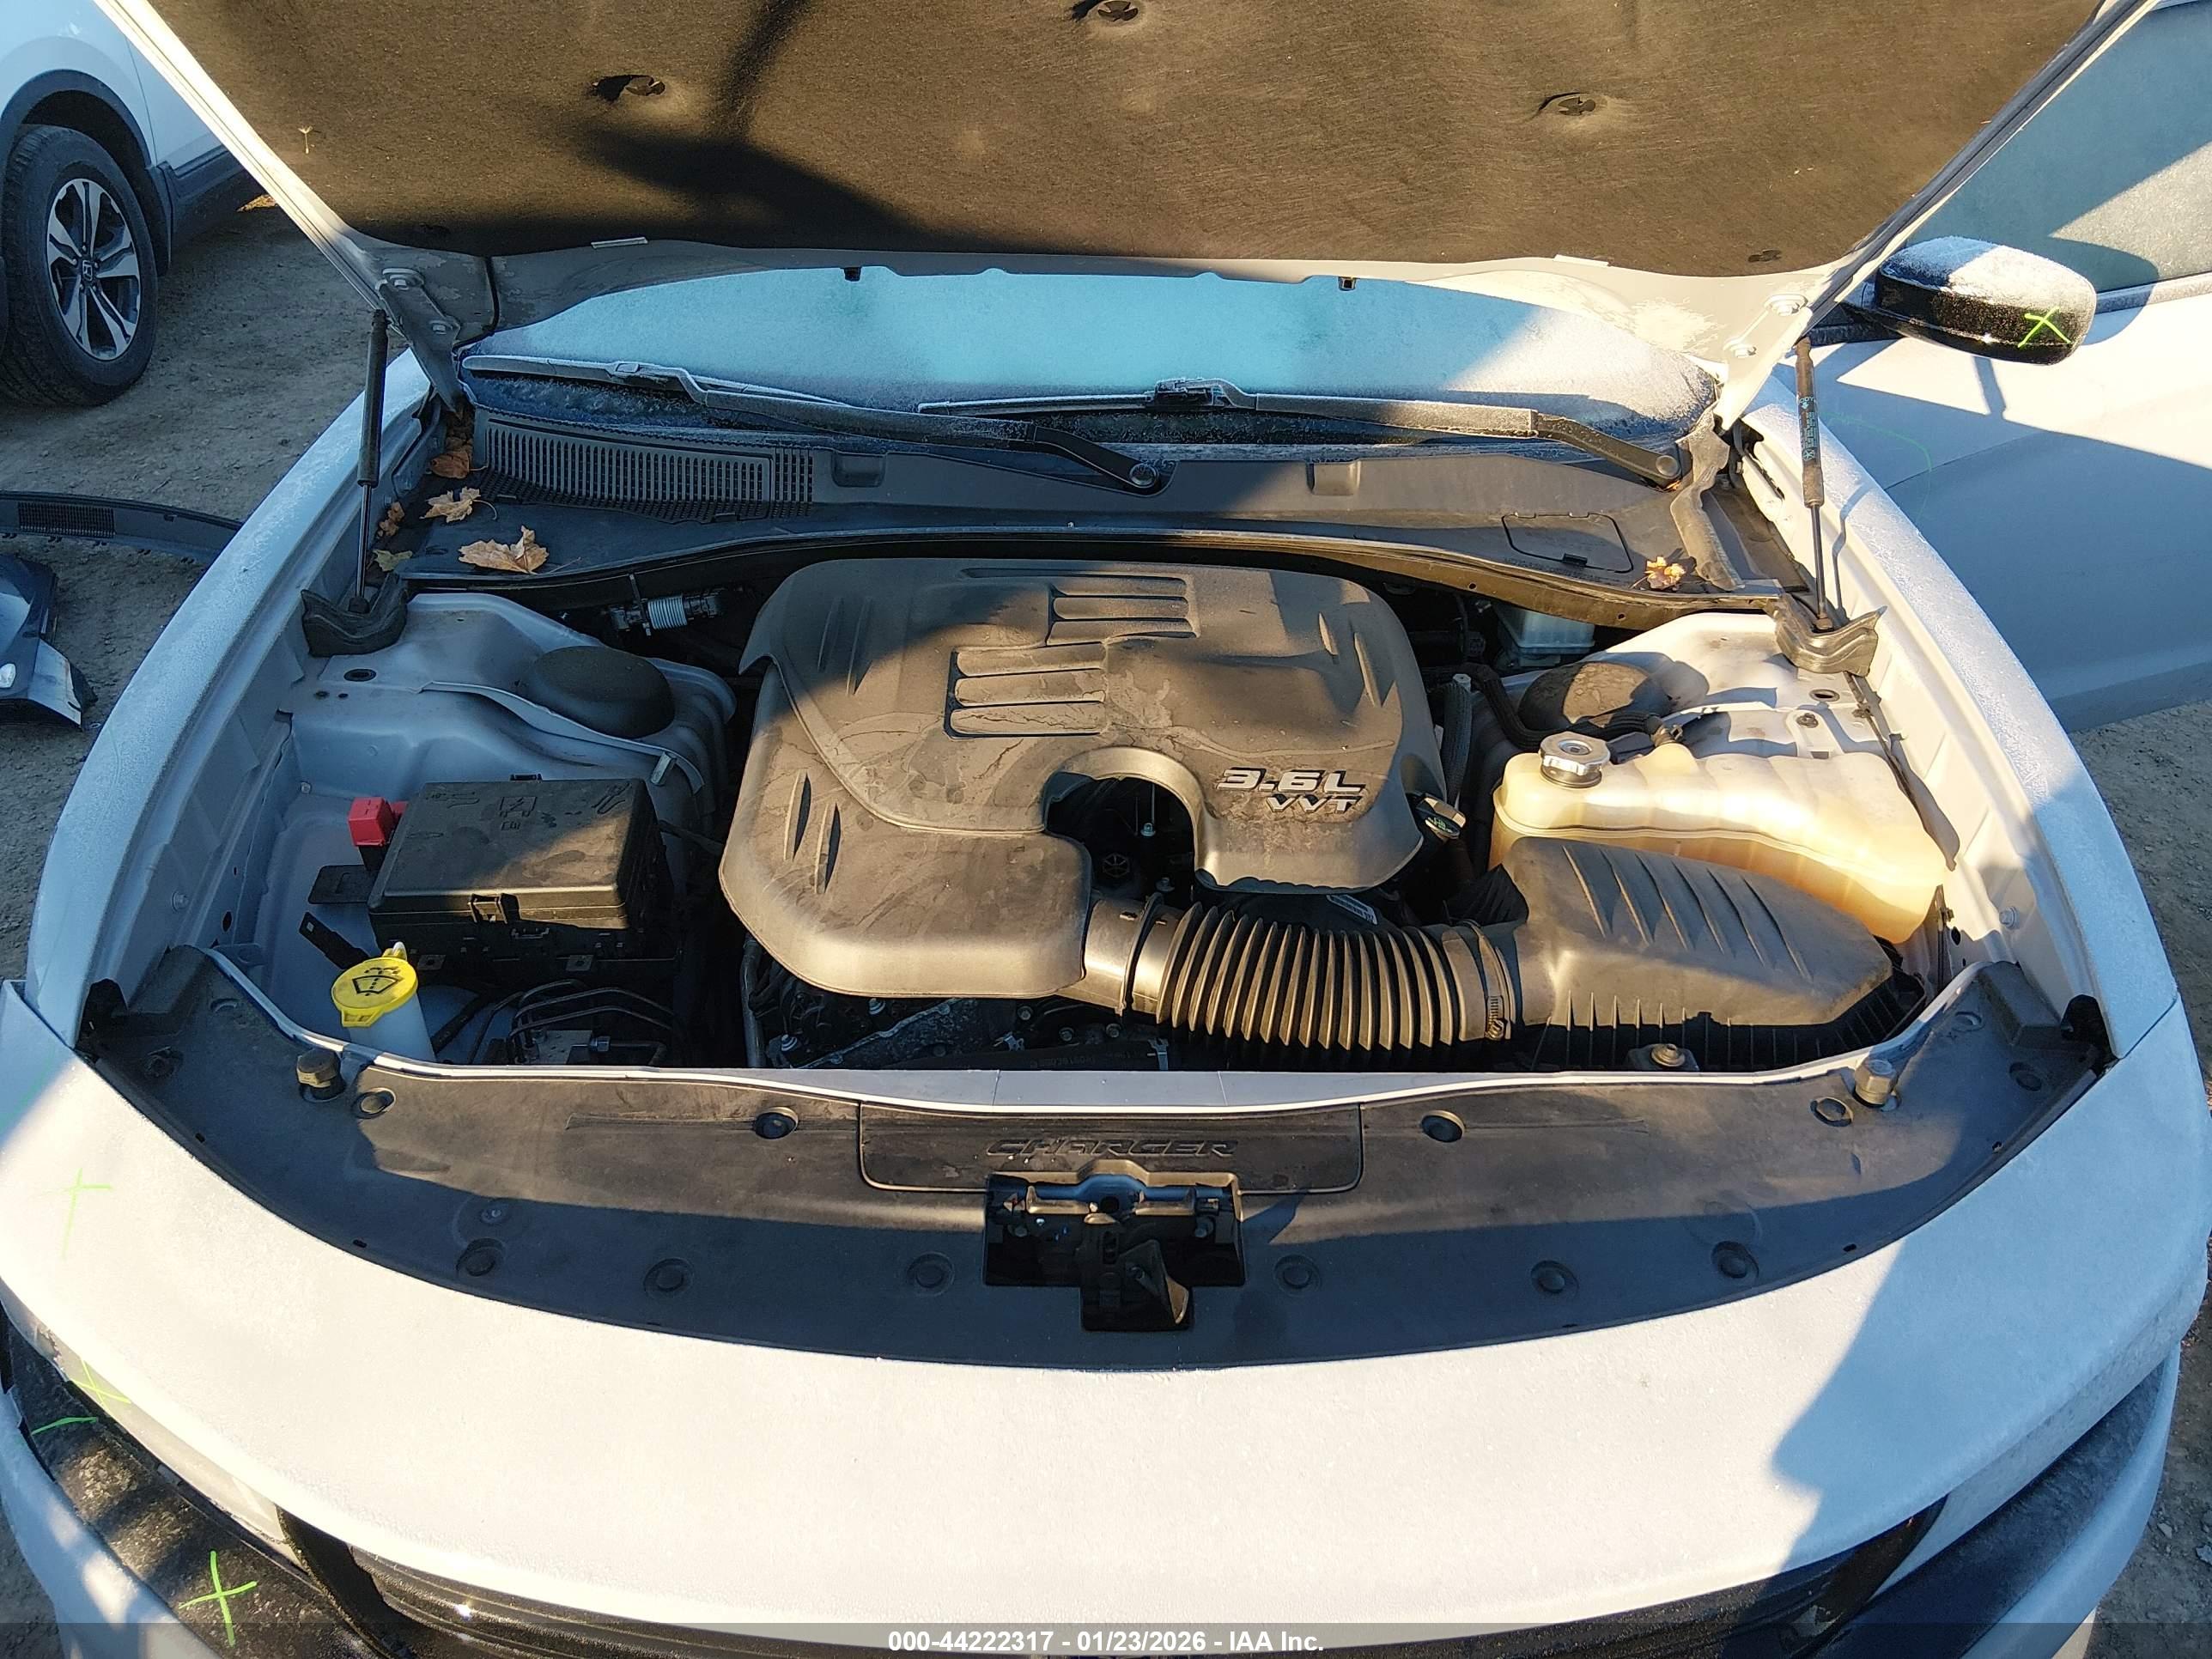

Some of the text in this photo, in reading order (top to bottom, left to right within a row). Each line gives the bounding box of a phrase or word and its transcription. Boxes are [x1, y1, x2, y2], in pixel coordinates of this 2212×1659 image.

[1216, 767, 1366, 793] 3.6L
[1265, 793, 1363, 812] VVT
[987, 1139, 1238, 1158] CHARGER
